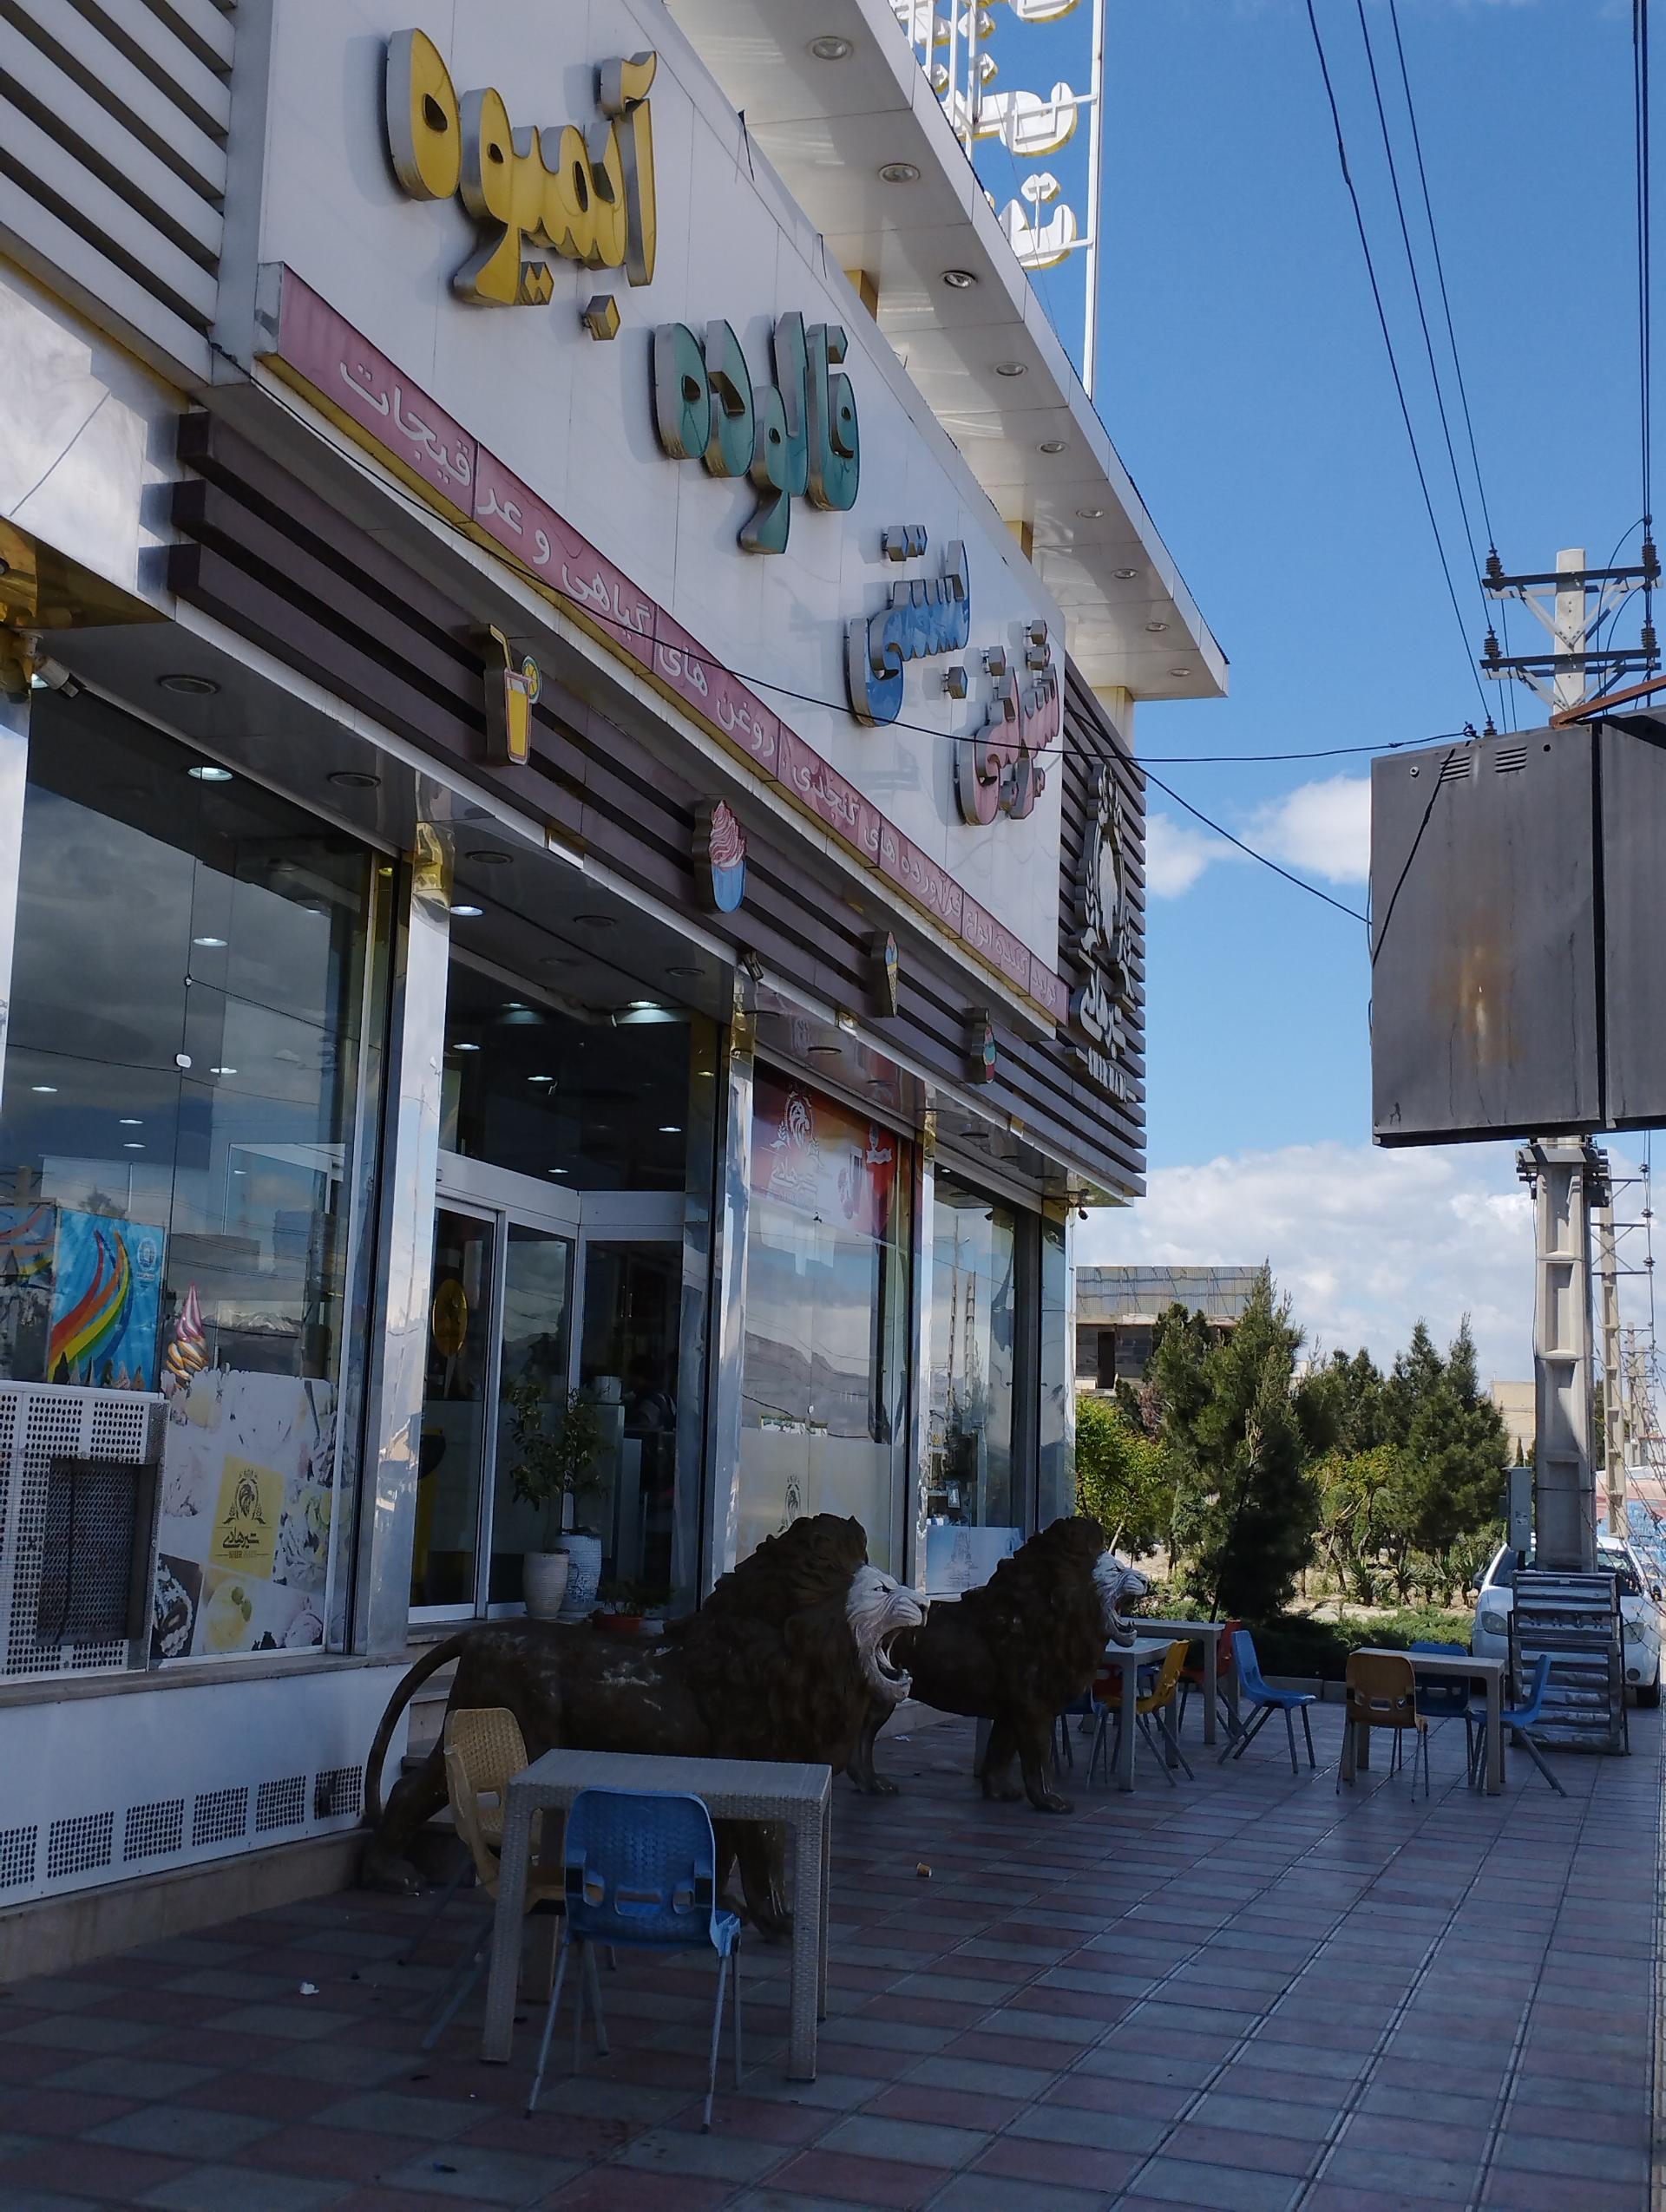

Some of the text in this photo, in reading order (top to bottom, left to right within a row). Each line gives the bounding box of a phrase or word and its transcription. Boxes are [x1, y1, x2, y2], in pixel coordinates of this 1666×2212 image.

[386, 27, 658, 341] آبمیوه
[654, 311, 859, 554] فالوده
[534, 527, 552, 566] و
[561, 562, 653, 640] گیاهی
[847, 524, 970, 728] بستنی
[659, 643, 708, 697] های
[717, 691, 775, 757] روغن
